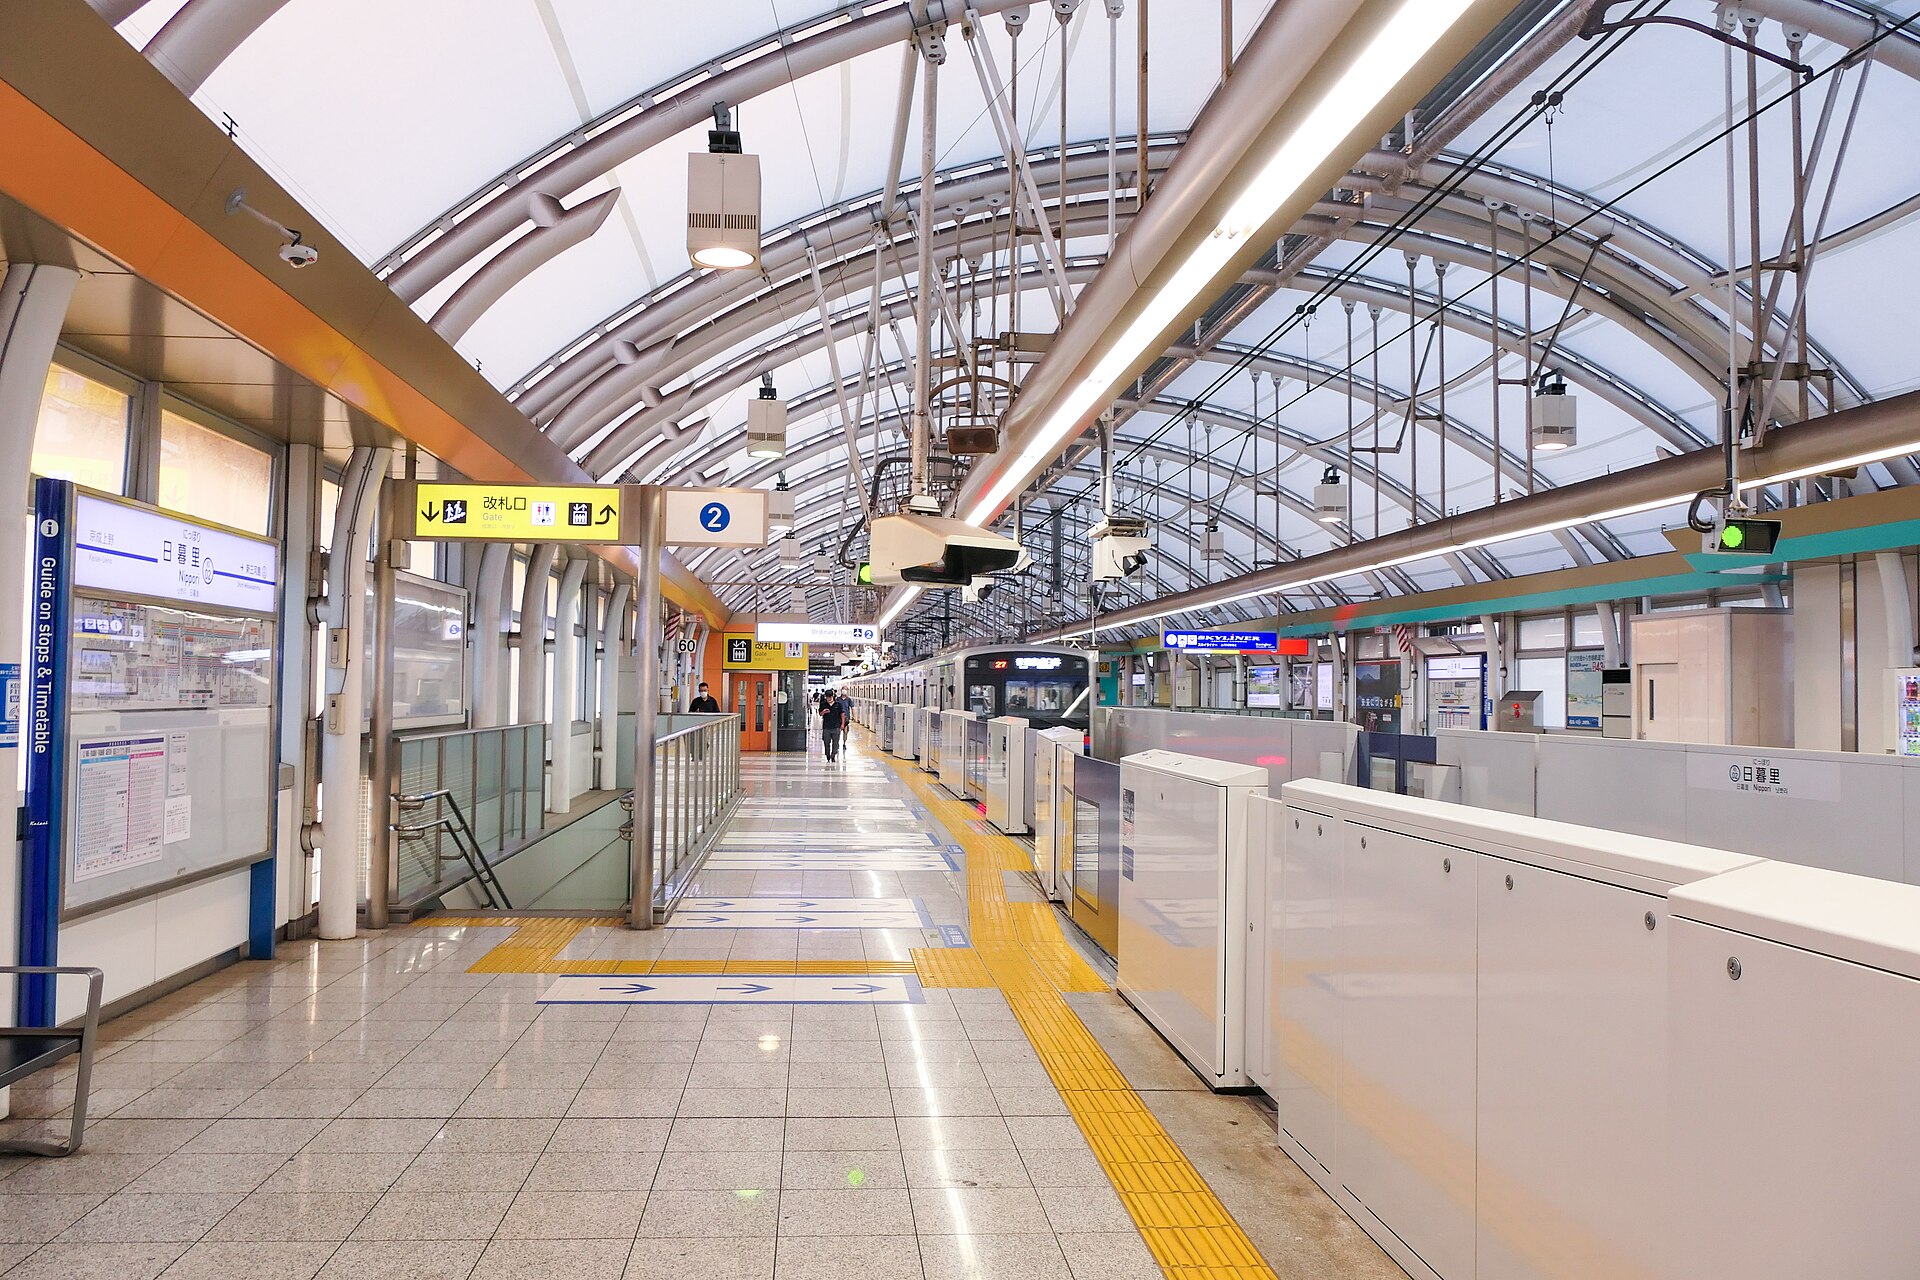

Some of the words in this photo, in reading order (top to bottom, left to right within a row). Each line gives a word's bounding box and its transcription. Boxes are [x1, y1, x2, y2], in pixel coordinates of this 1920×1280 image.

[483, 496, 527, 511] 改札口
[482, 512, 503, 521] Gate
[708, 507, 722, 528] 2
[89, 529, 114, 546] 京成上野
[163, 540, 200, 568] 日暮里
[40, 557, 57, 599] Guide
[39, 602, 52, 620] on
[811, 628, 838, 637] Ordinary
[35, 624, 53, 663] stops
[678, 639, 696, 652] 60
[37, 667, 52, 679] &
[994, 661, 1007, 669] 27
[35, 681, 53, 754] Timetable
[1743, 766, 1781, 785] 日暮里
[1753, 784, 1772, 793] Nippori
